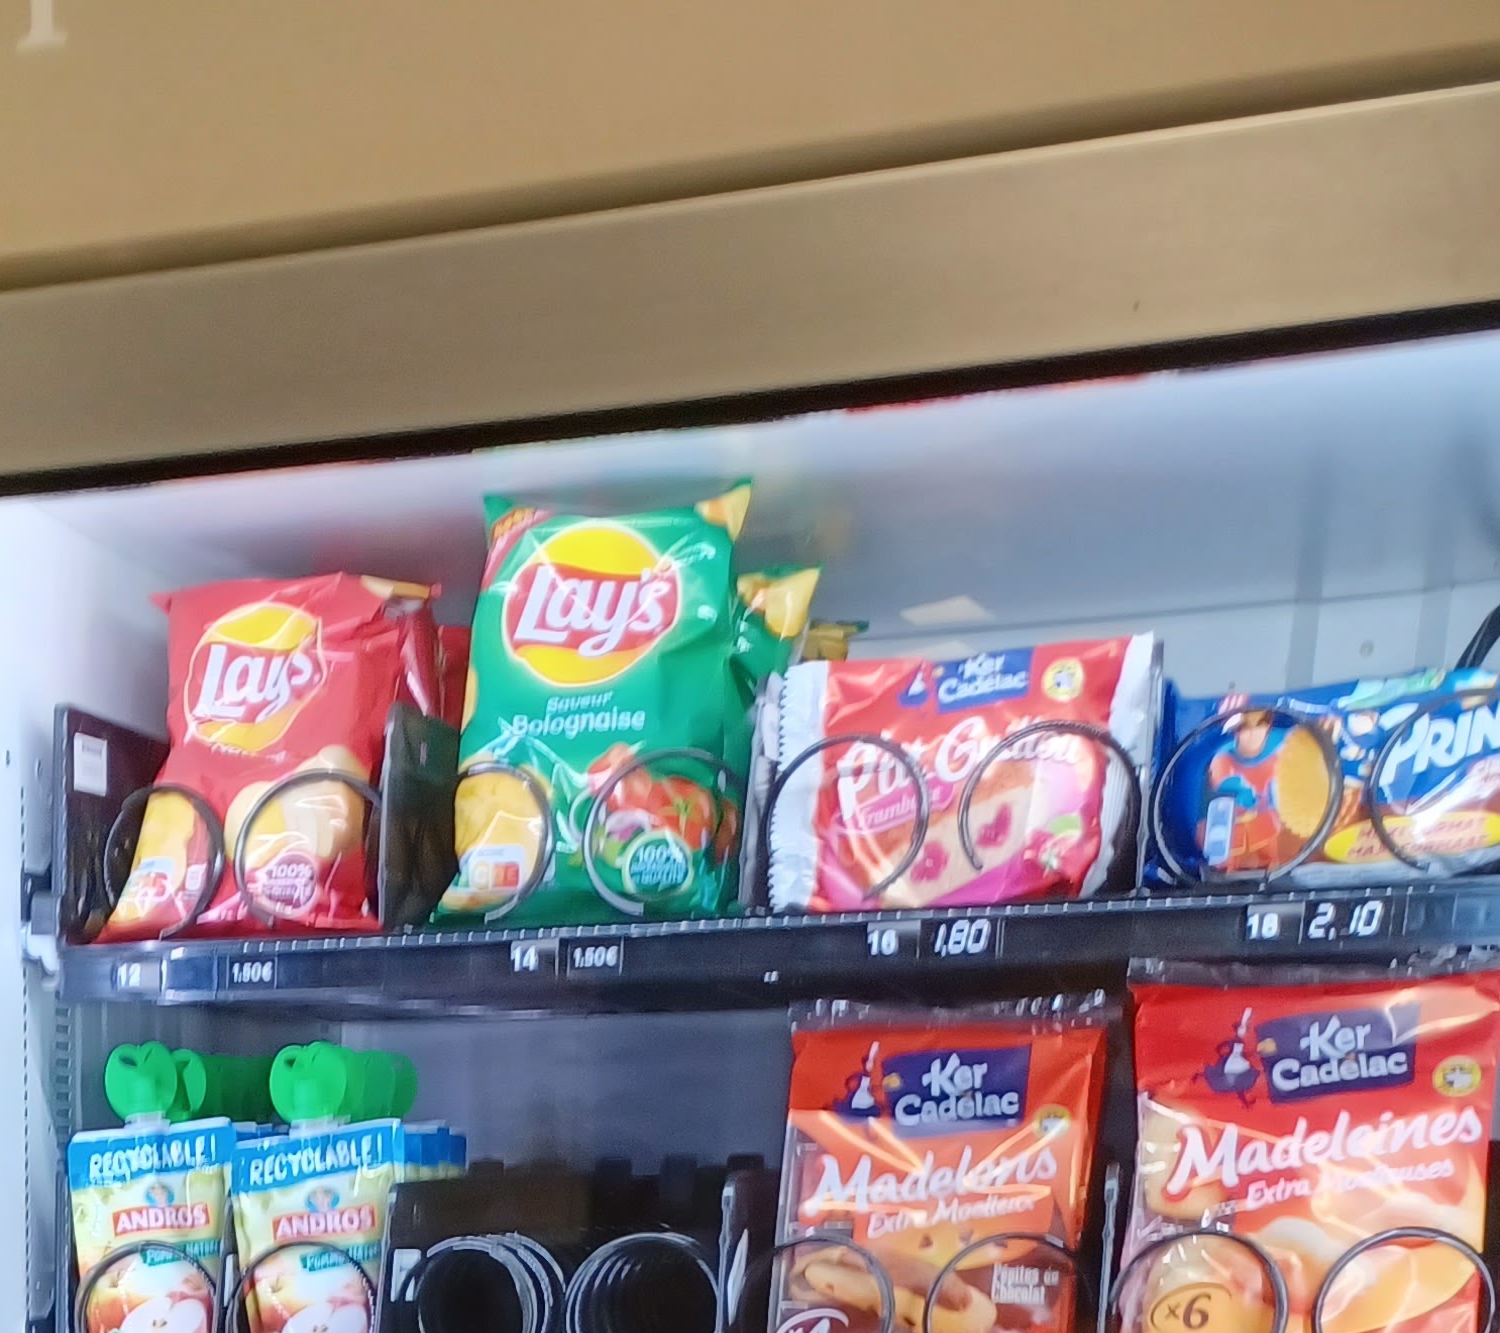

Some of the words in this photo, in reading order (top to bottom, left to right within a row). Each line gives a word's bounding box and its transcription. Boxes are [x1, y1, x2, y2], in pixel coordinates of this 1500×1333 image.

[514, 564, 671, 657] Lay's
[513, 707, 646, 739] Bolognaise
[512, 945, 540, 972] 14
[1300, 1014, 1372, 1060] Ker
[922, 1051, 990, 1099] Ker
[1272, 1050, 1409, 1092] Cadélac
[894, 1088, 1021, 1127] Cadélac
[1163, 1105, 1484, 1199] Madeleines
[1244, 1177, 1312, 1209] Extra
[116, 1207, 208, 1233] ANDROS
[275, 1207, 374, 1239] ANDROS
[1161, 1292, 1212, 1332] x6
